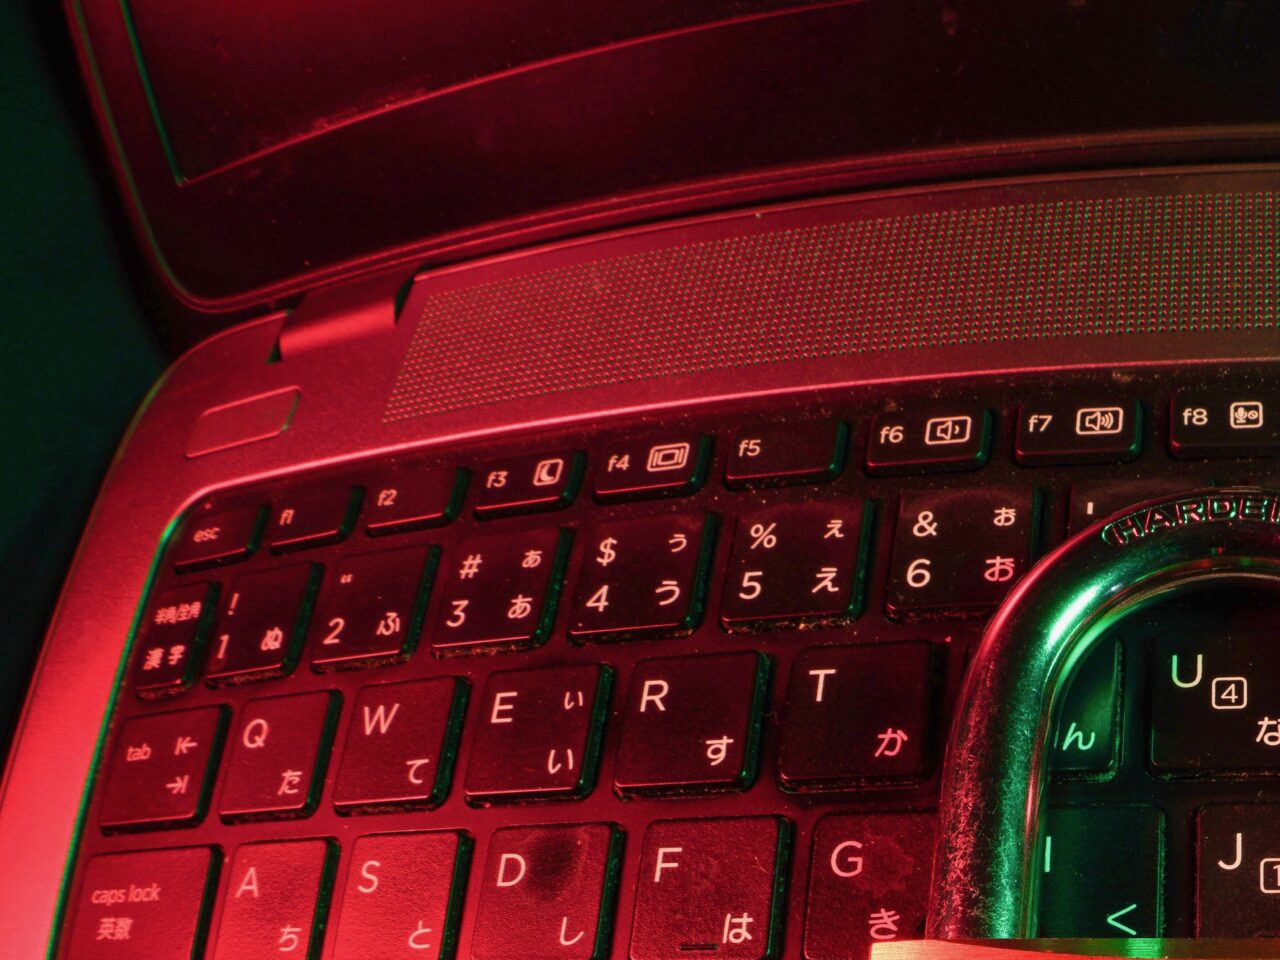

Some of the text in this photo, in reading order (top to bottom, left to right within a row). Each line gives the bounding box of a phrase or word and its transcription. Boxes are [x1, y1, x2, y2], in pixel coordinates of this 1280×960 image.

[1029, 415, 1052, 432] f7
[1183, 408, 1208, 425] f8
[880, 426, 903, 443] f6
[739, 440, 760, 456] f5
[608, 455, 629, 471] f4
[487, 471, 508, 488] f3
[378, 489, 397, 506] f2
[280, 509, 294, 525] f1
[913, 511, 937, 536] &
[194, 527, 220, 542] esc
[751, 523, 776, 549] %
[597, 537, 617, 566] $
[460, 554, 482, 579] #
[907, 559, 930, 587] 6
[984, 556, 1014, 581] お
[656, 581, 680, 605] う
[739, 572, 762, 599] 5
[812, 568, 839, 593] え
[228, 593, 239, 615] !
[508, 595, 532, 618] あ
[586, 585, 608, 611] 4
[377, 612, 400, 635] ふ
[447, 600, 468, 627] 3
[323, 618, 344, 644] 2
[218, 635, 229, 659] 1
[1172, 654, 1202, 688] U
[640, 680, 668, 712] R
[809, 669, 835, 701] T
[1221, 684, 1238, 703] 4
[364, 704, 399, 735] W
[491, 692, 517, 723] E
[243, 719, 268, 748] Q
[875, 728, 908, 757] か
[1063, 723, 1095, 750] ん
[127, 744, 151, 761] tab
[548, 749, 573, 774] い
[706, 736, 733, 765] す
[278, 770, 302, 795] た
[407, 759, 429, 784] て
[654, 847, 682, 882] F
[831, 841, 863, 877] G
[1218, 833, 1242, 870] J
[236, 867, 258, 897] A
[358, 861, 380, 893] S
[497, 854, 526, 886] D
[1273, 865, 1280, 886] 1
[92, 883, 160, 906] caps lock
[97, 918, 133, 940] 英数
[409, 921, 431, 948] と
[560, 917, 583, 945] し
[723, 913, 753, 943] は
[869, 908, 899, 940] き
[279, 925, 301, 951] ち
